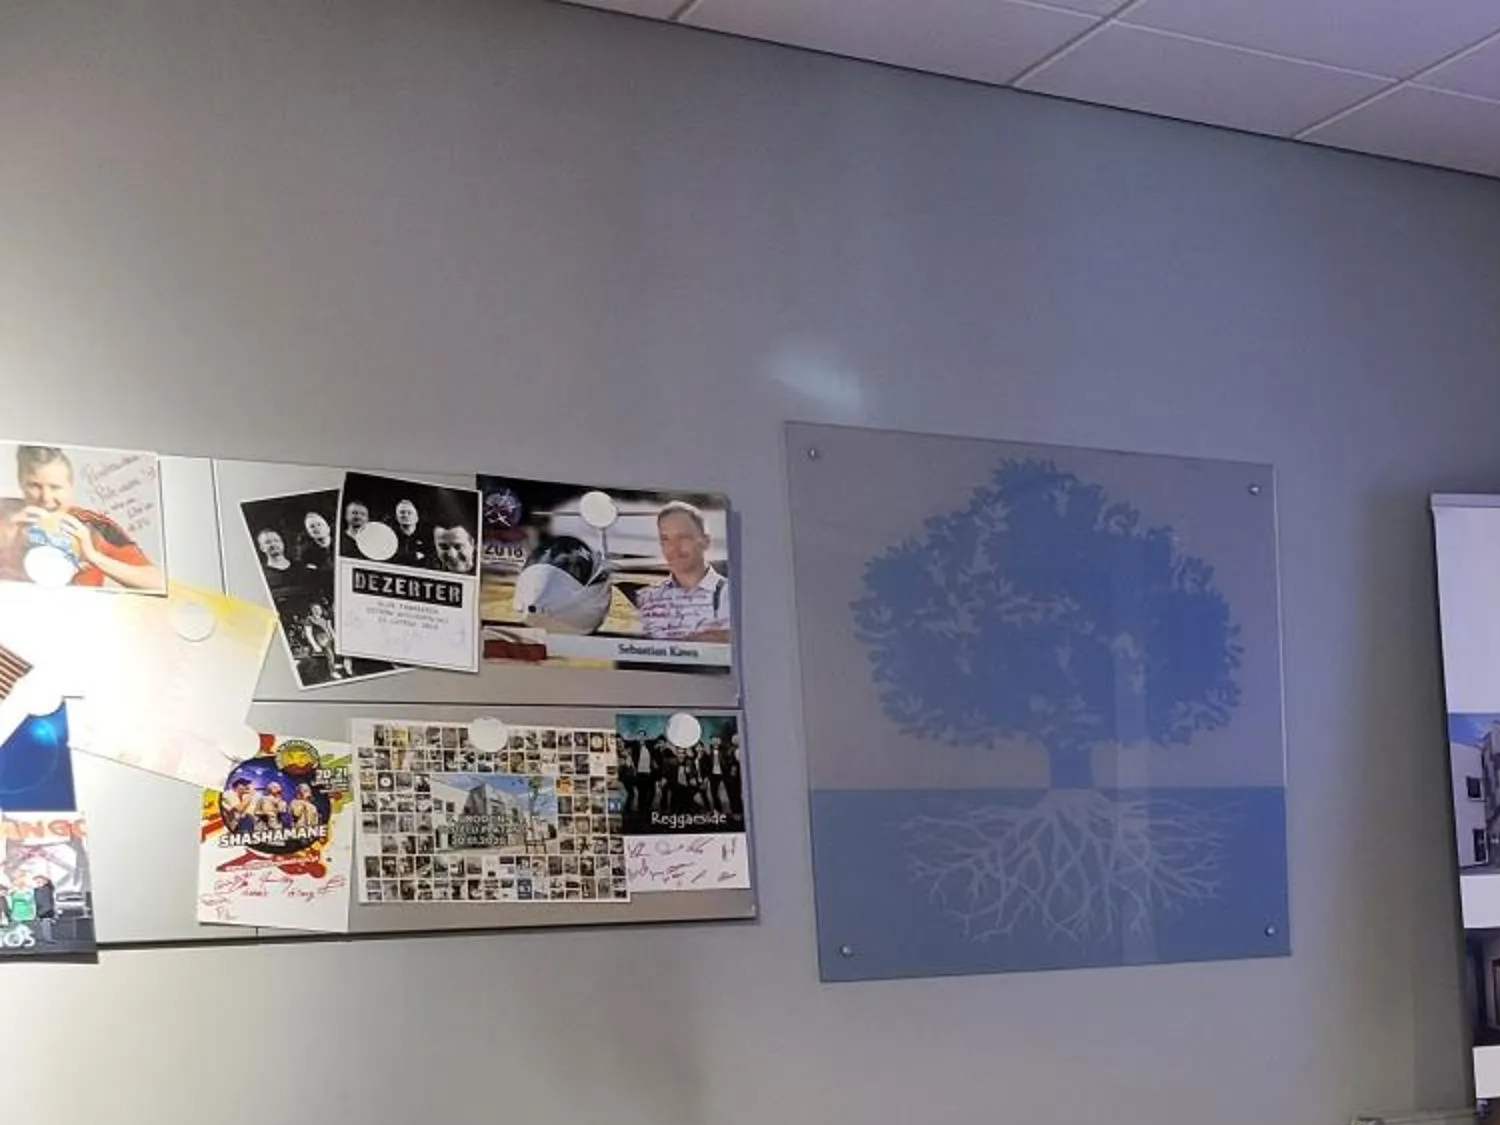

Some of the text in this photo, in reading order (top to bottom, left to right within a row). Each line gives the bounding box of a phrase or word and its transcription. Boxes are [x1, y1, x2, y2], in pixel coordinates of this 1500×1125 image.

[354, 570, 461, 602] DEZERTER
[617, 643, 667, 657] Sebastian
[219, 825, 328, 848] SHASHAMANE
